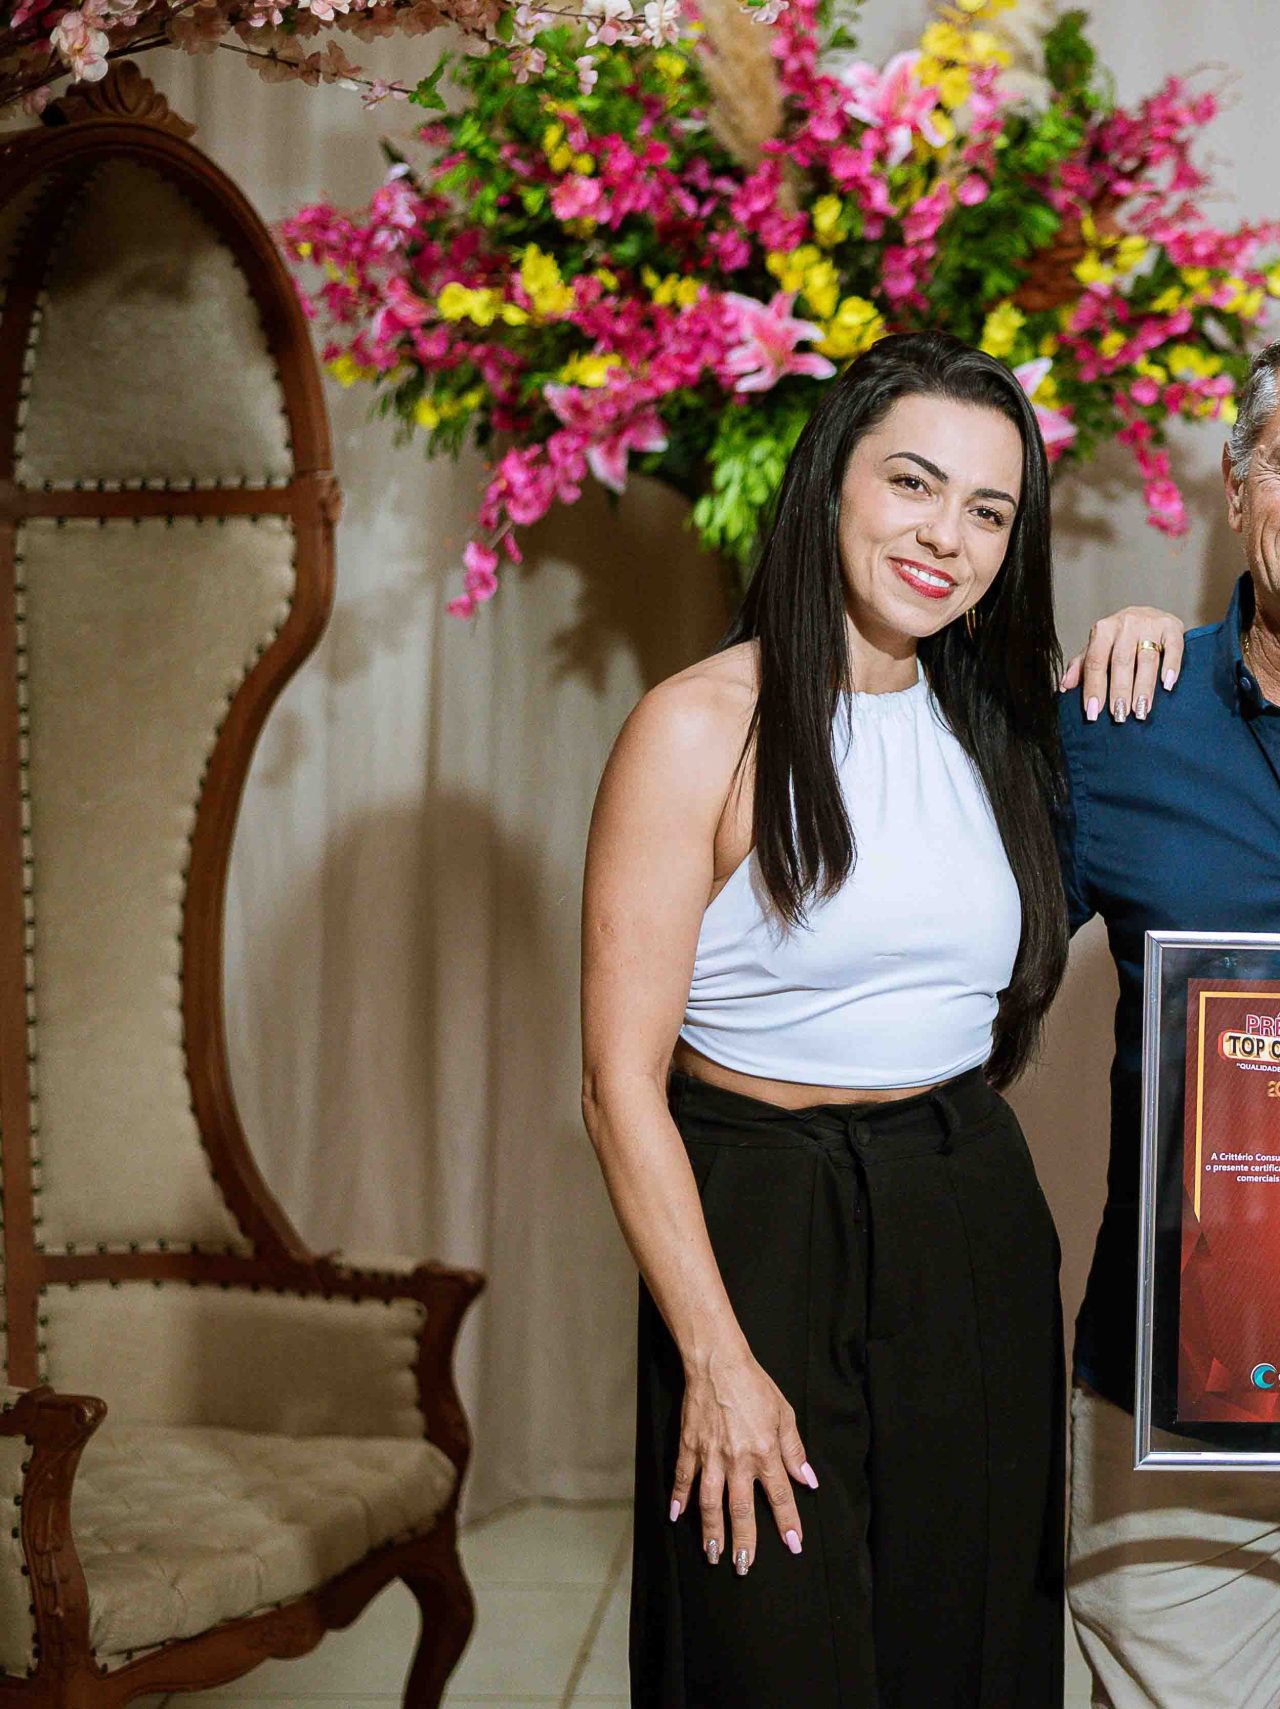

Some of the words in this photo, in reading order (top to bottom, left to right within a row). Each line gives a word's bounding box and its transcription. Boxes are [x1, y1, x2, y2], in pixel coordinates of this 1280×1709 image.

[1225, 1035, 1265, 1057] TOP
[1211, 1152, 1218, 1161] A
[1220, 1152, 1254, 1161] Crittério
[1205, 1164, 1212, 1172] o
[1213, 1164, 1249, 1173] presente
[1236, 1174, 1280, 1183] comerciais
